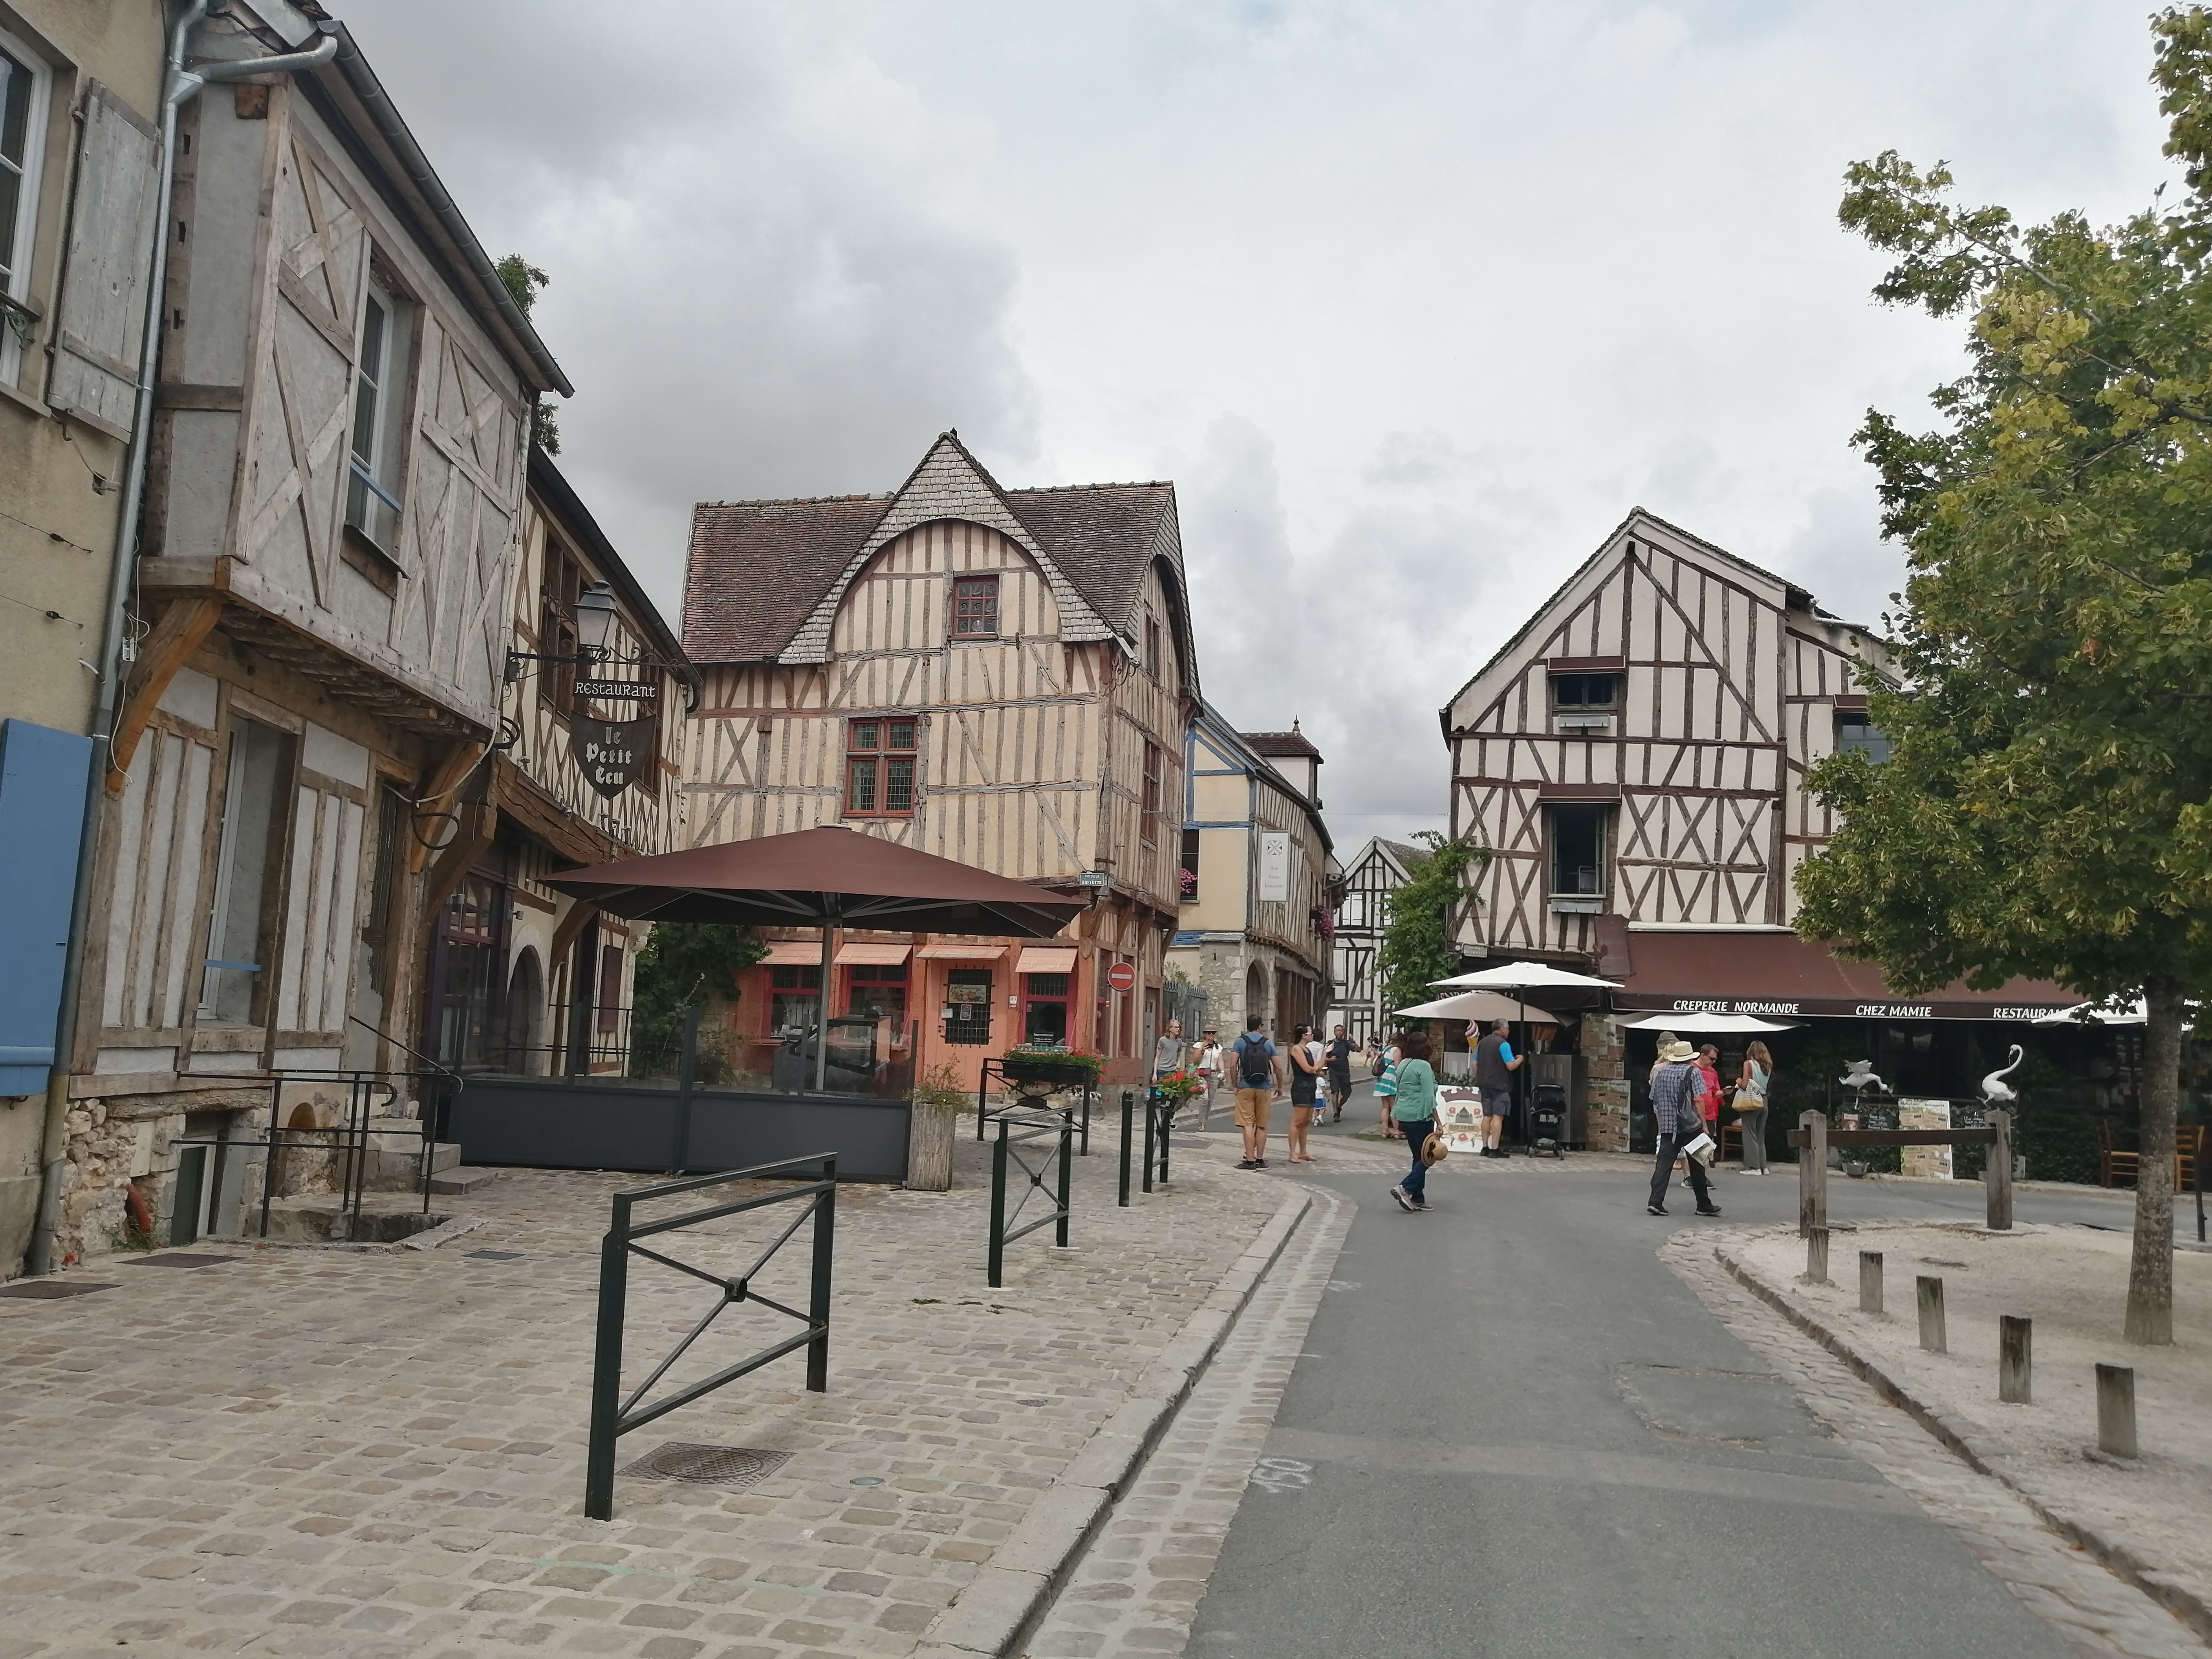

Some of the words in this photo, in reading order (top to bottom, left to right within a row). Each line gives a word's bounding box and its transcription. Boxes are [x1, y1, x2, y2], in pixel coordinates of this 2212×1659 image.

[586, 742, 632, 764] Petit
[1673, 1000, 1729, 1011] CREPERIE
[1734, 1002, 1800, 1013] NORMANDE
[1856, 1005, 1886, 1016] CHEZ
[1889, 1006, 1932, 1017] MAMIE
